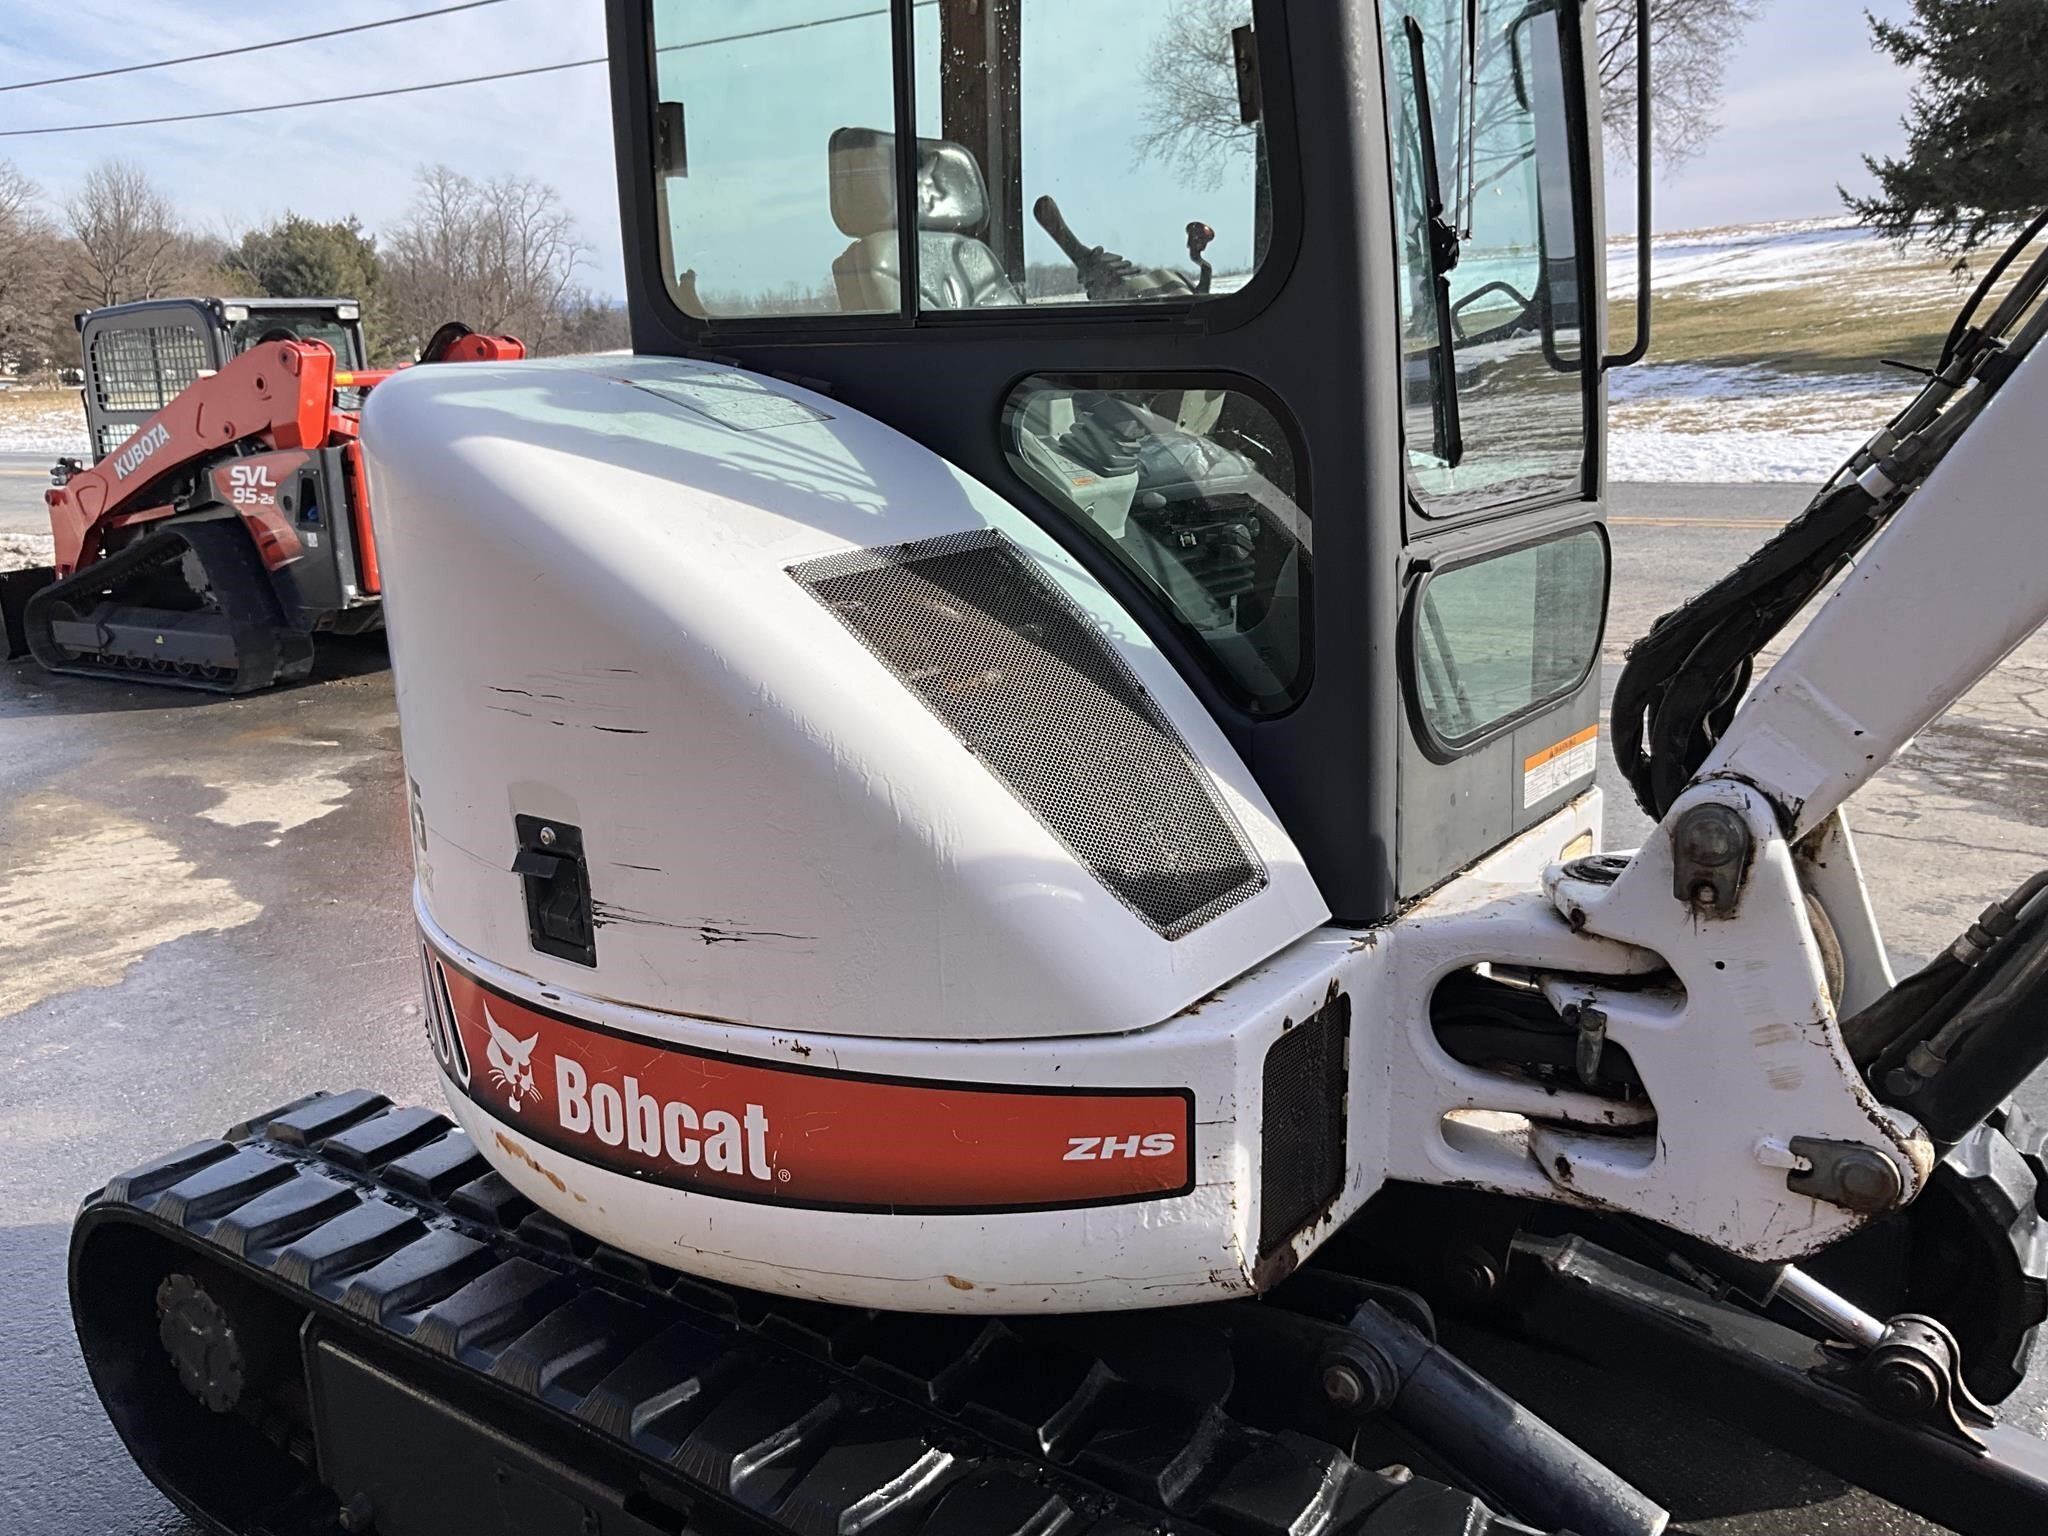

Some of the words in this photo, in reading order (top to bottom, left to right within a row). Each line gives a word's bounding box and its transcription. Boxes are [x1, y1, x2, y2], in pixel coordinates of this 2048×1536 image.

[113, 423, 170, 480] KUBOTA
[230, 465, 276, 486] SVL
[554, 1053, 772, 1182] Bobcat
[1062, 1132, 1176, 1161] ZHS
